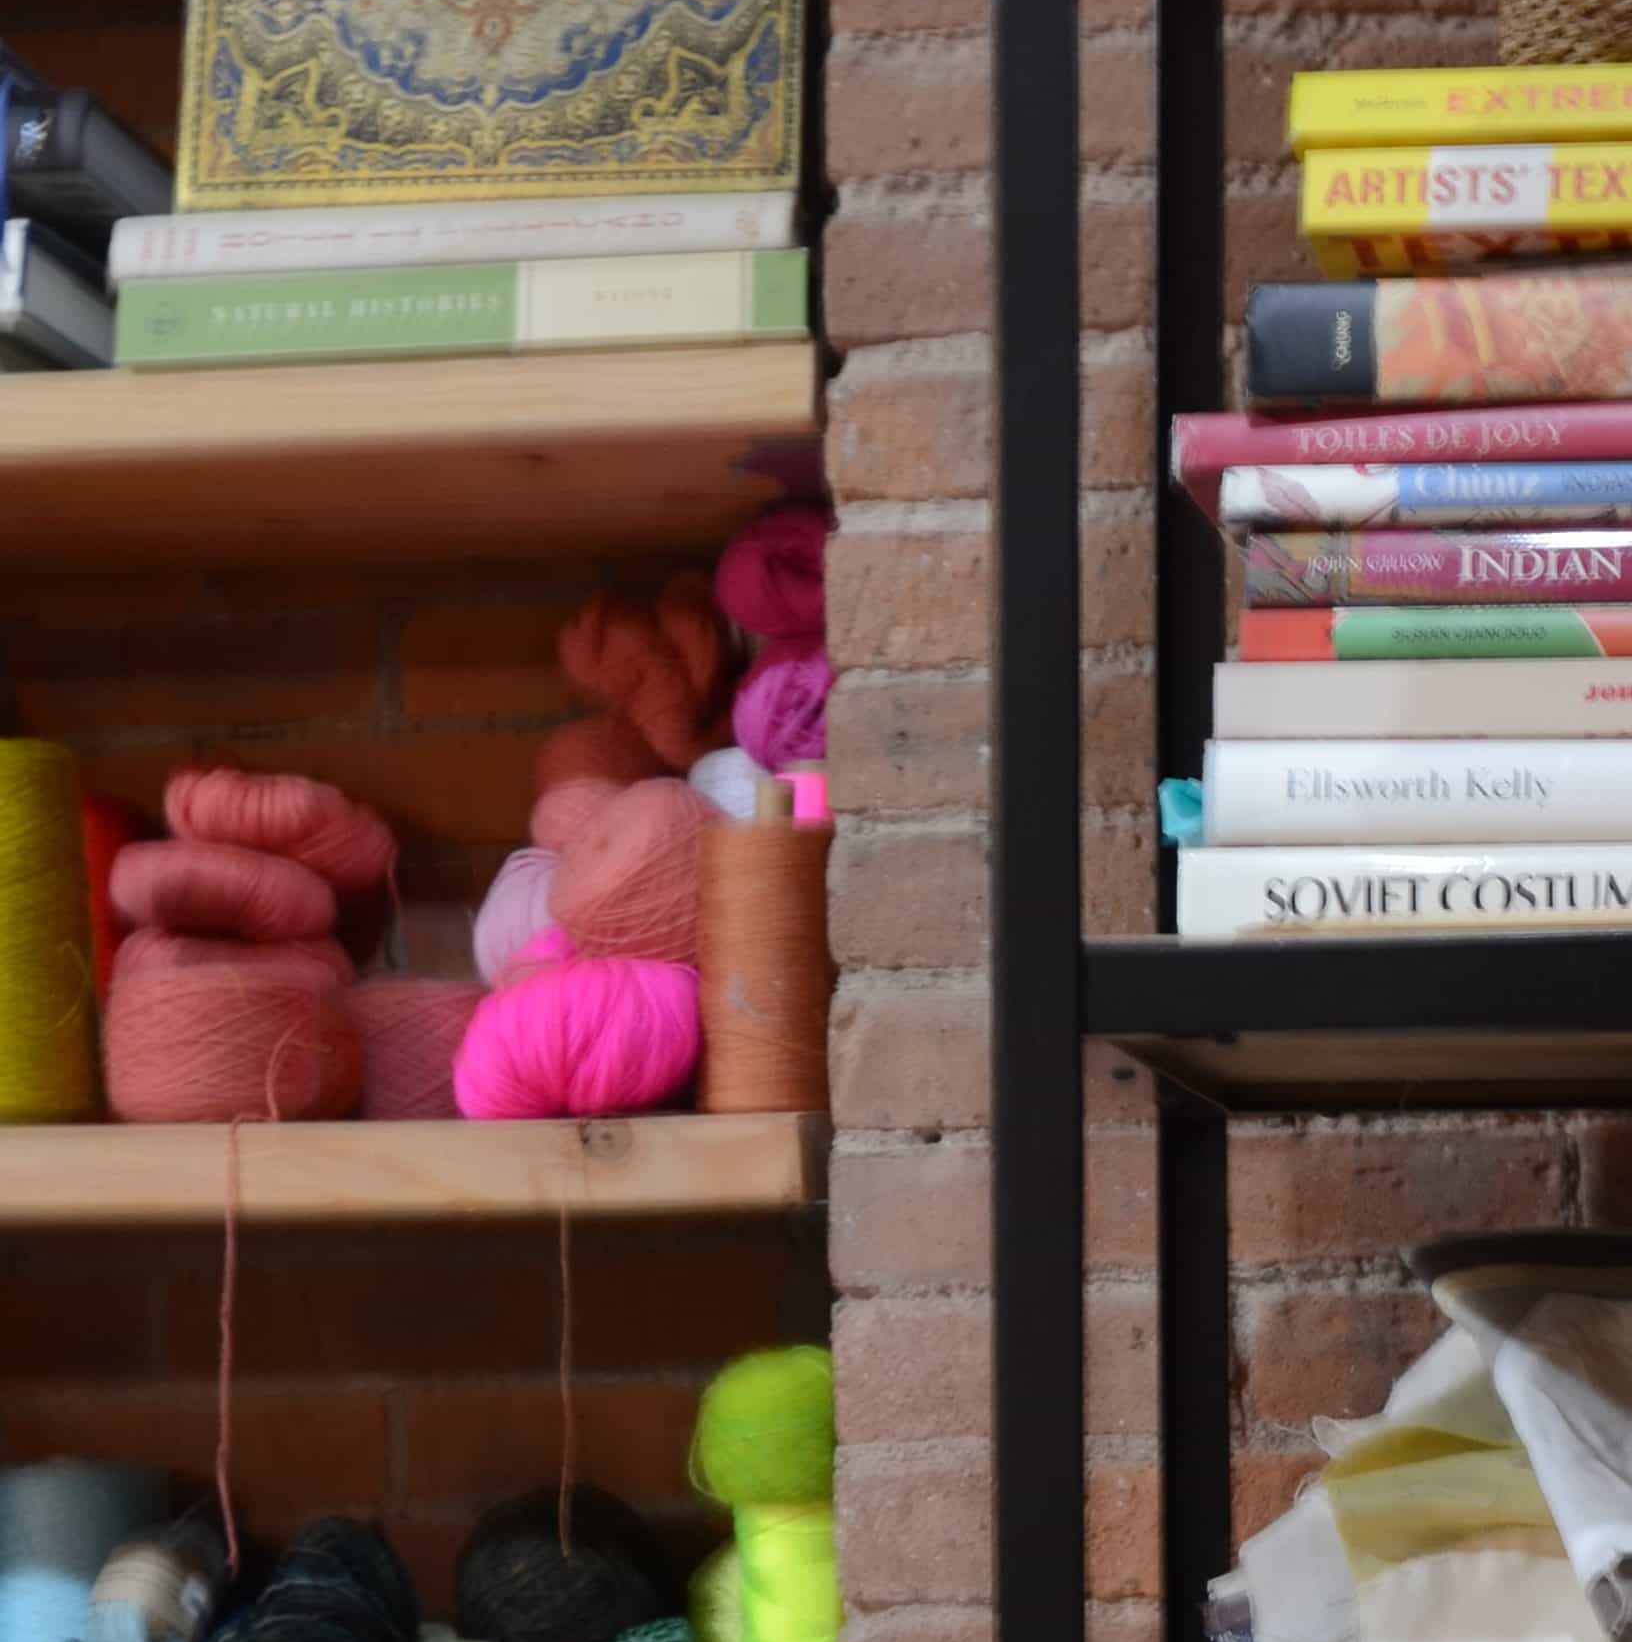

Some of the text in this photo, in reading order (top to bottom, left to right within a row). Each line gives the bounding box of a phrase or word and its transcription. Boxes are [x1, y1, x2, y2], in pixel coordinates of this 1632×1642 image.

[1325, 163, 1531, 208] ARTISTS'
[1291, 417, 1568, 457] TOILES DE JOUY
[1454, 543, 1623, 585] INDIAN
[1285, 766, 1452, 802] Ellsworth
[1464, 765, 1554, 810] Kelly
[1262, 873, 1426, 923] SOVIET
